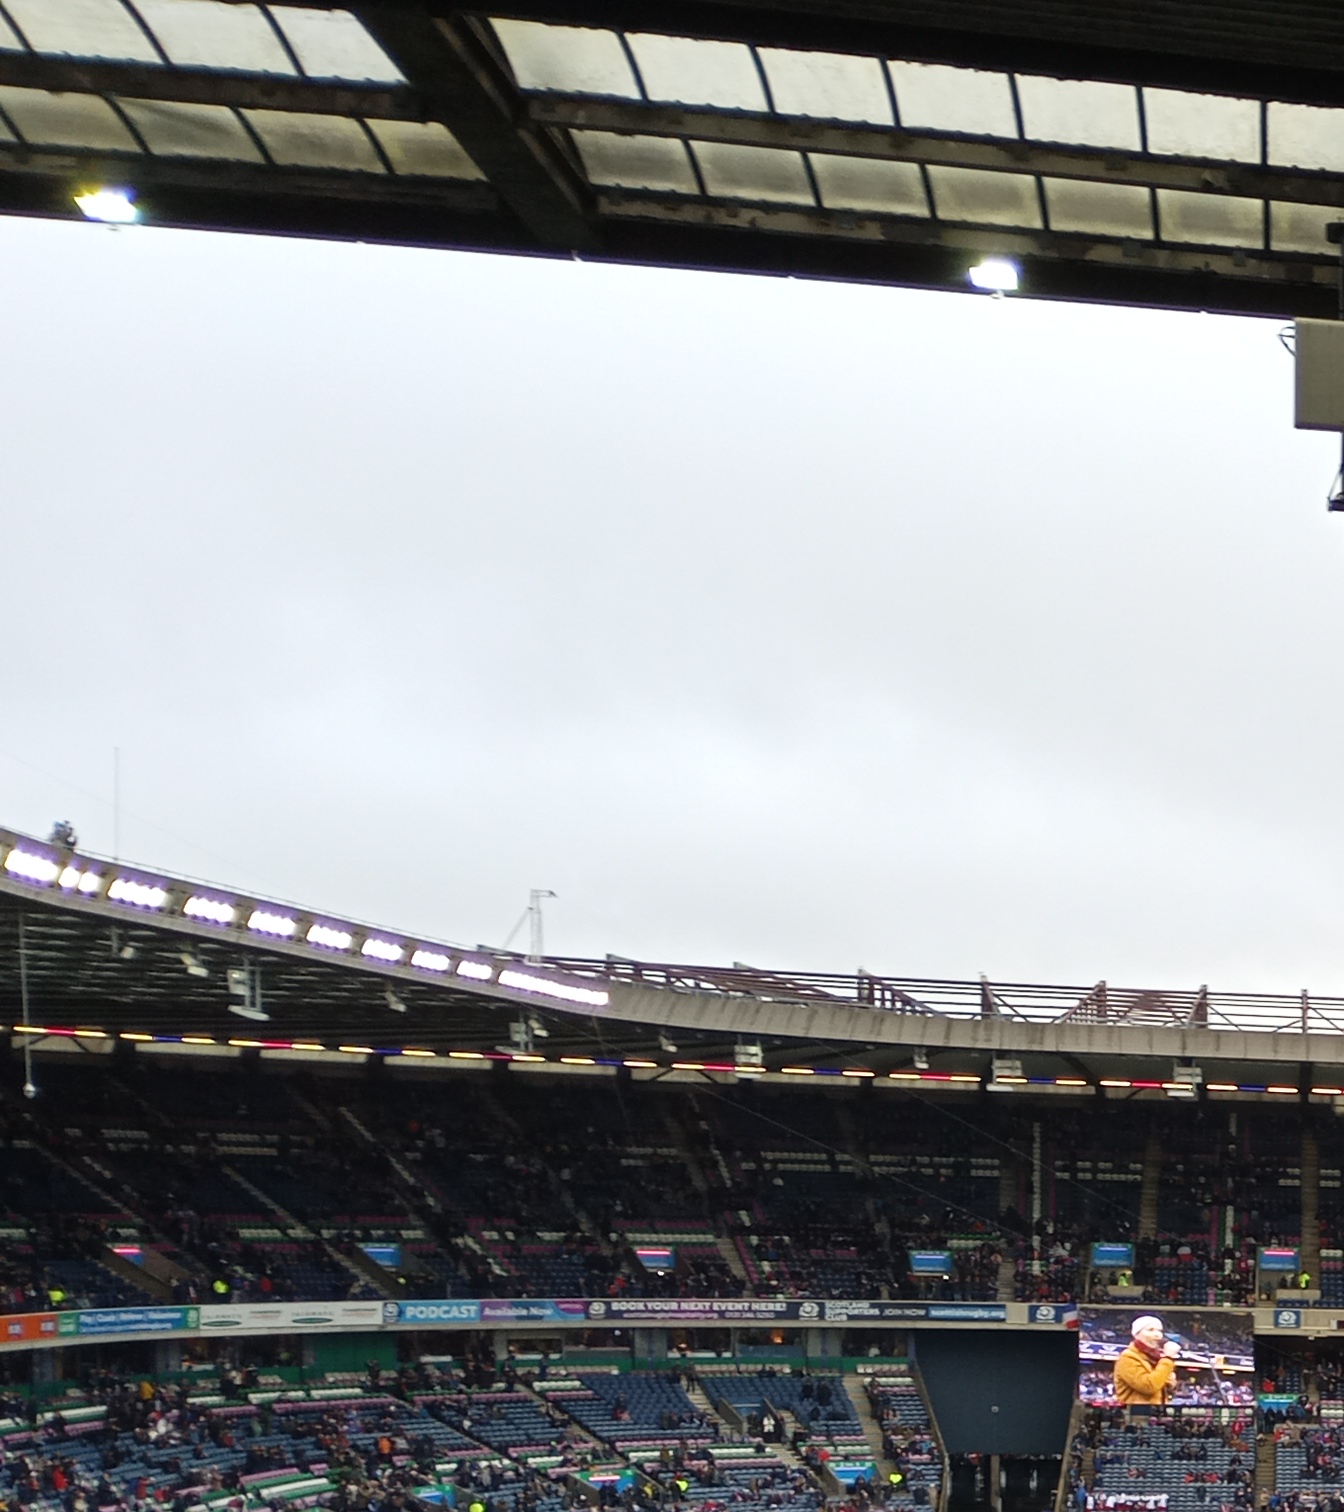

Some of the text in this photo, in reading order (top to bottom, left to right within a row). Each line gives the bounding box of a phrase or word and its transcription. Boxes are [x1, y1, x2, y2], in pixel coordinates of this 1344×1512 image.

[647, 1302, 678, 1310] YOUR
[680, 1302, 711, 1310] NEXT
[713, 1302, 749, 1310] EVENT
[405, 1305, 478, 1319] PODCAST
